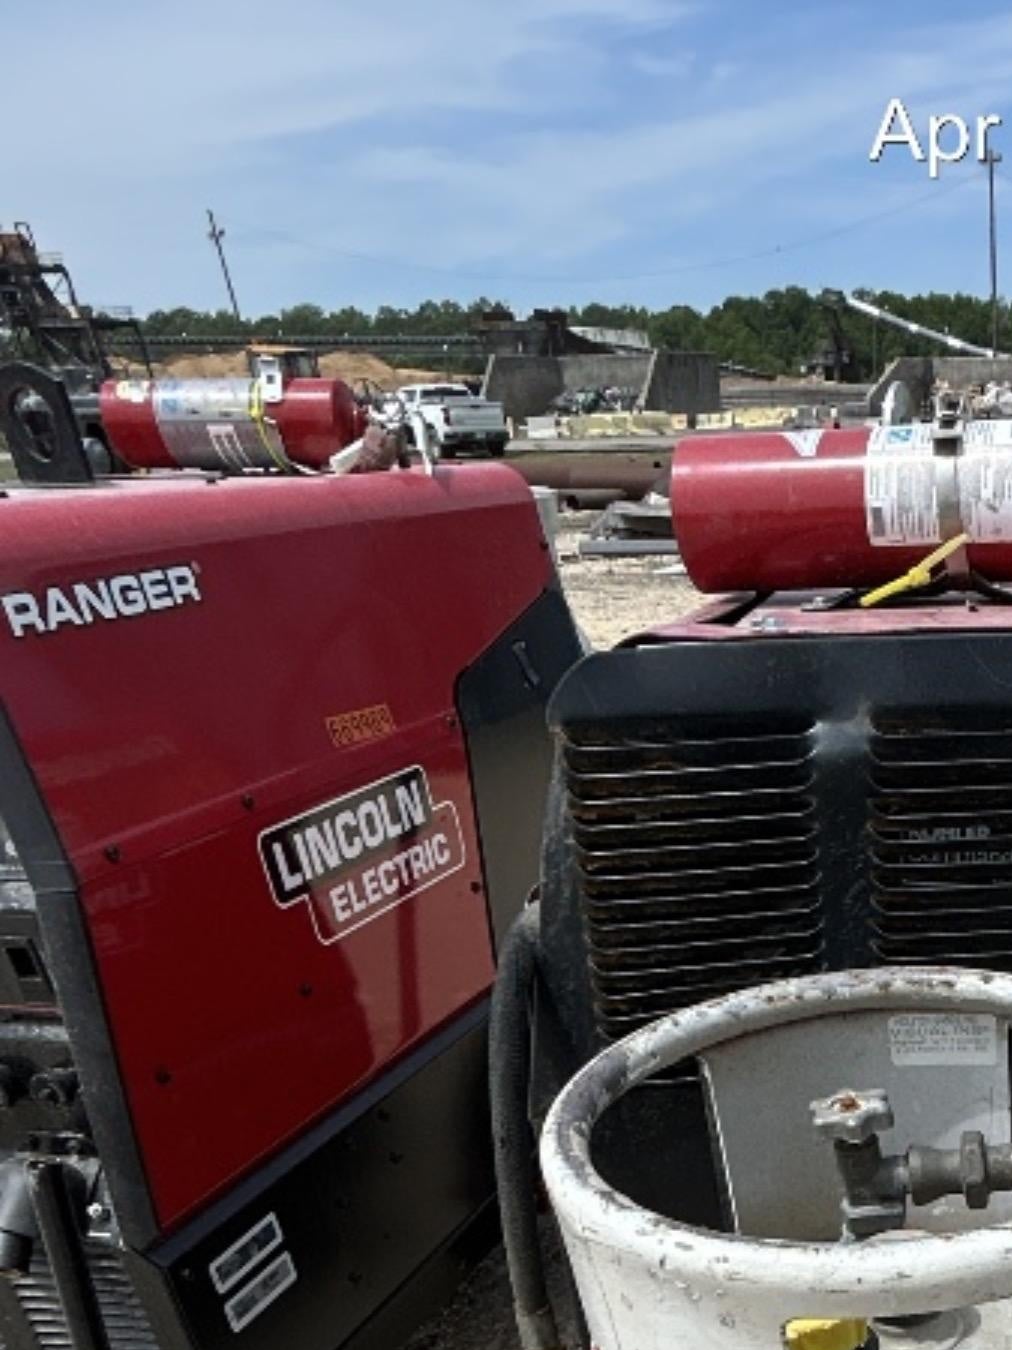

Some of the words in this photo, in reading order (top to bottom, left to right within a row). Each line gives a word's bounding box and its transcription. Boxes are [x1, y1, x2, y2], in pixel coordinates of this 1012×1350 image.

[0, 565, 201, 637] RANGER
[271, 779, 427, 892] LINCOLN
[328, 832, 451, 923] ELECTRIC
